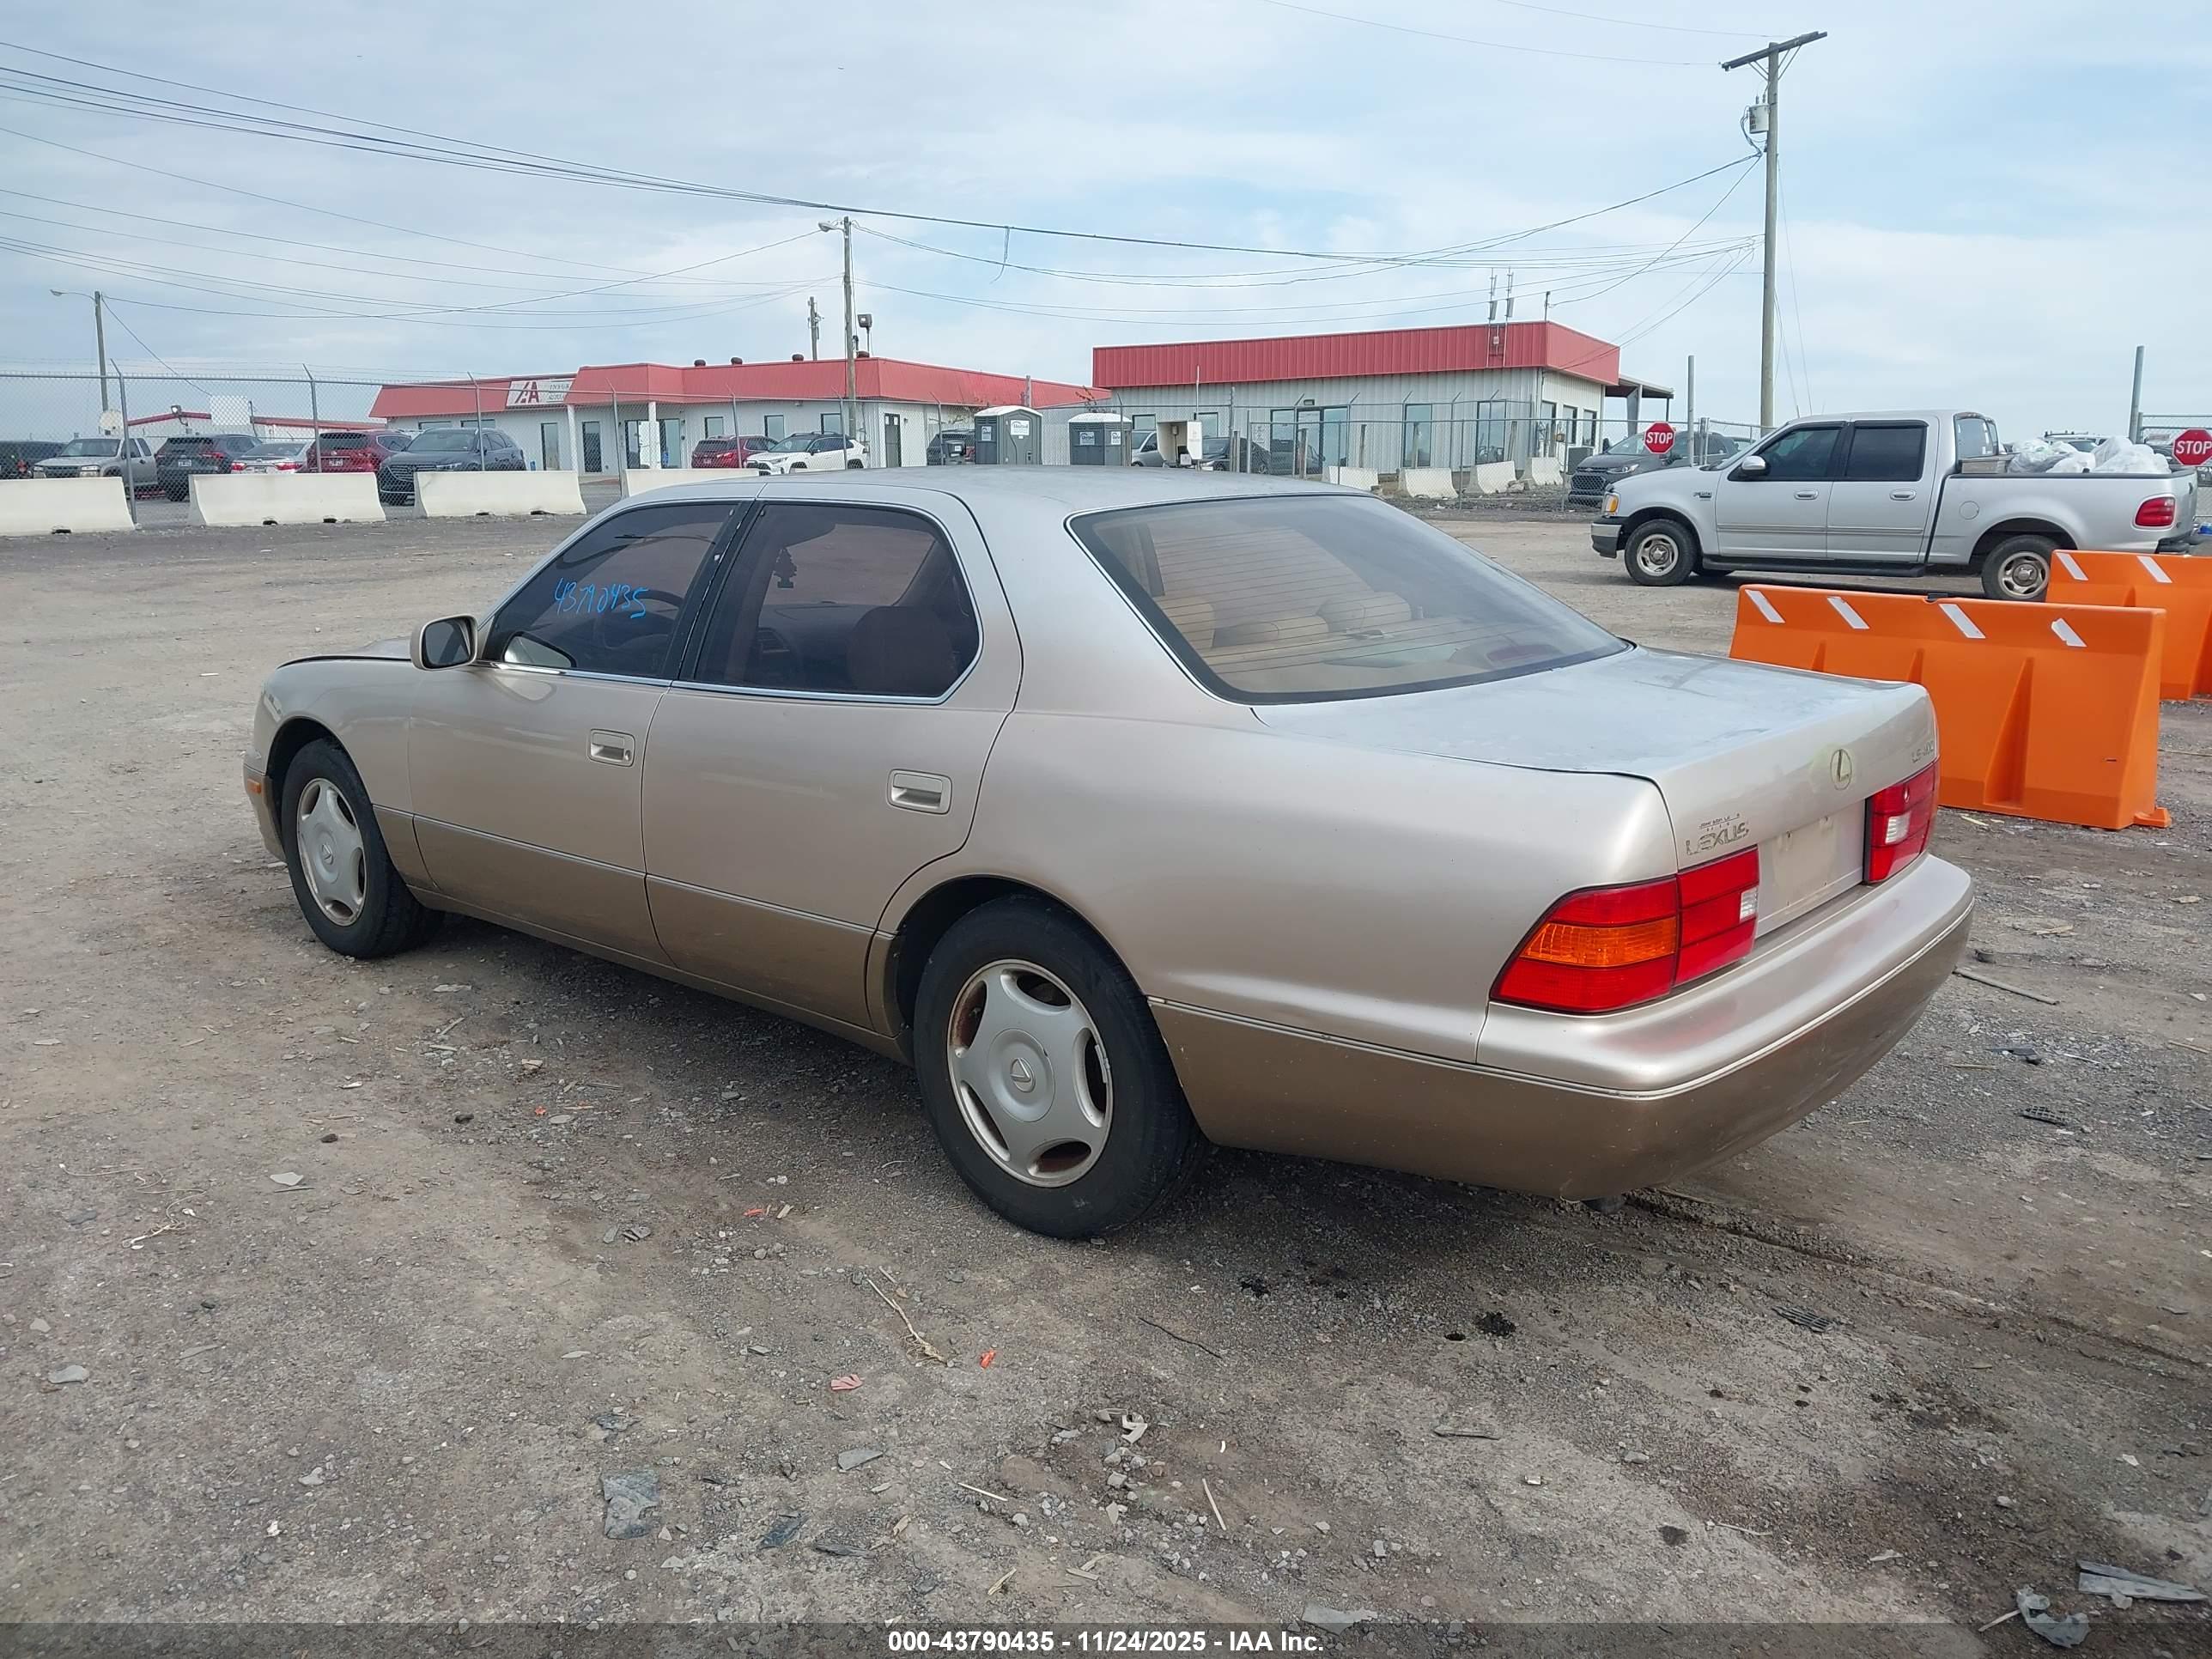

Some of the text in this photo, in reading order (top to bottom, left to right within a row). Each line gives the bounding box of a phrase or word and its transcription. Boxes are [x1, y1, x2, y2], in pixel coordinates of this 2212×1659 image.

[1646, 432, 1674, 444] STOP
[2175, 440, 2212, 454] STOP
[555, 577, 649, 618] 43790435
[1686, 822, 1749, 855] LEXUS
